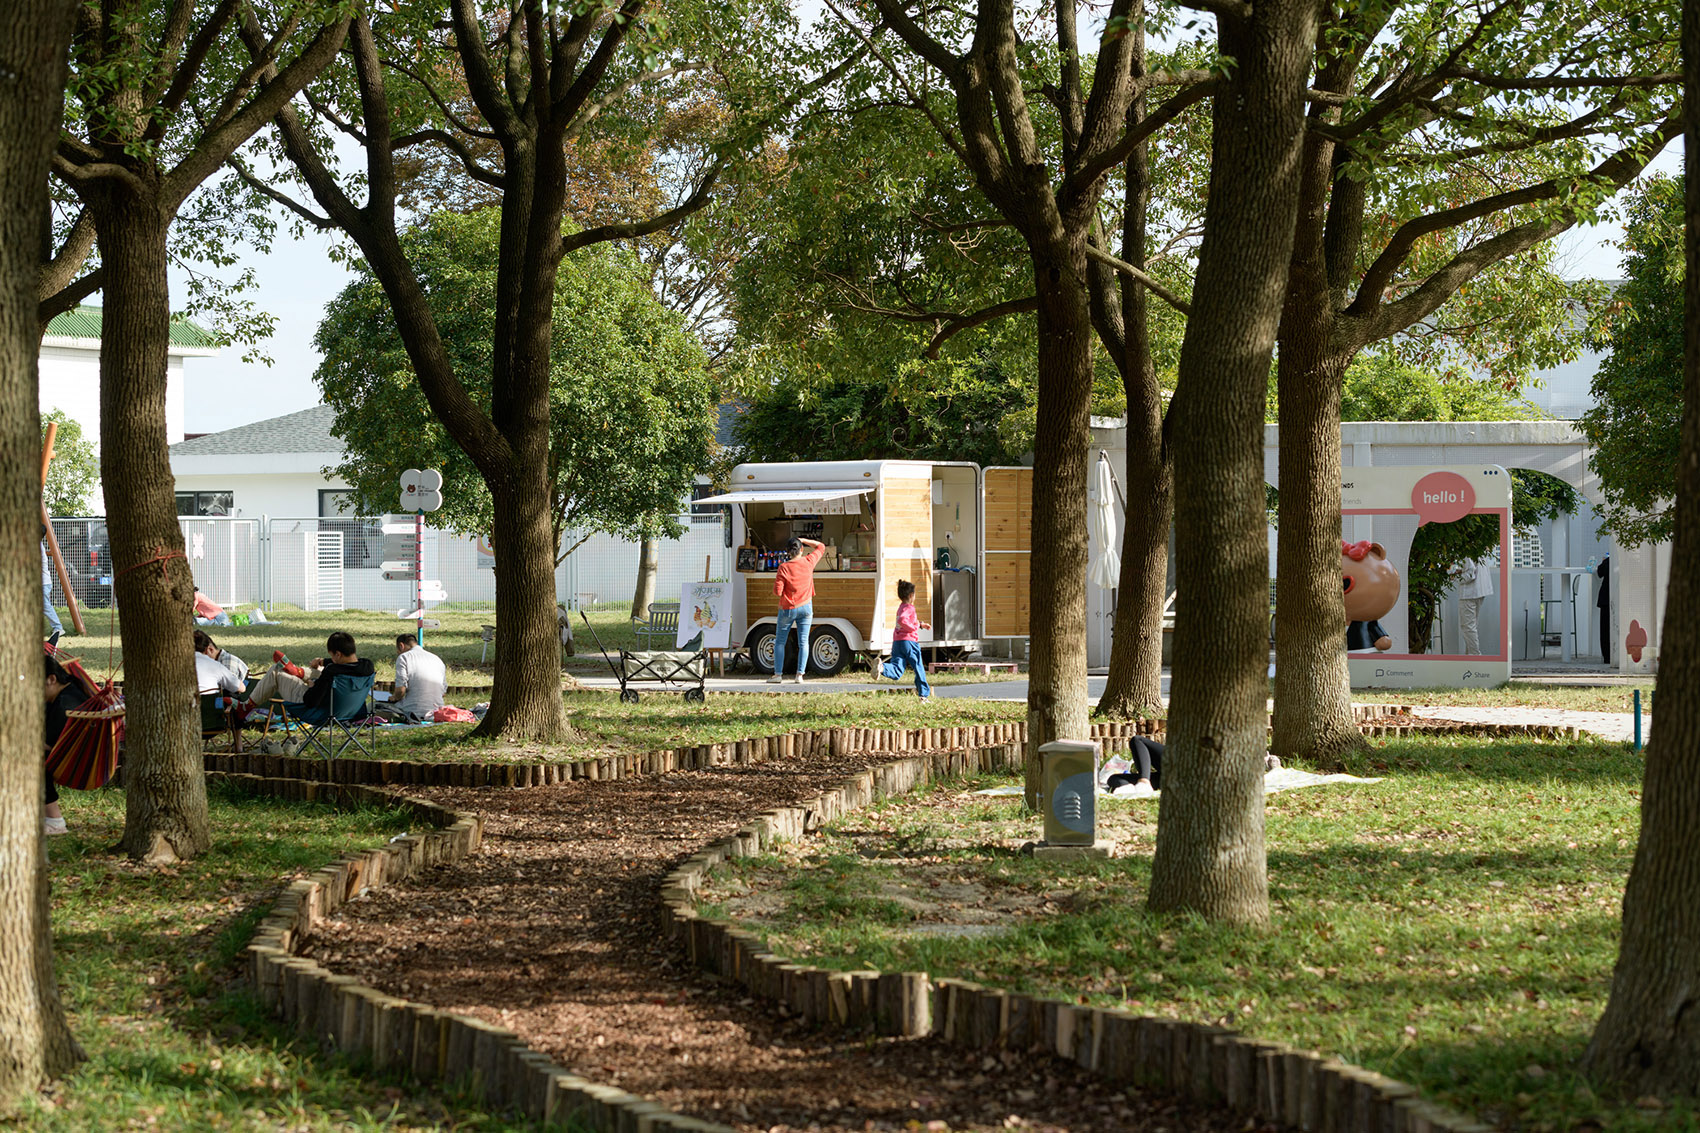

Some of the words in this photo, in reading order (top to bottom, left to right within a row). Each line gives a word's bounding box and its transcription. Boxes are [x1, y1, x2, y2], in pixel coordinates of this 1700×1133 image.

[1424, 490, 1457, 504] hello
[1460, 489, 1465, 503] !
[1474, 671, 1491, 679] Share
